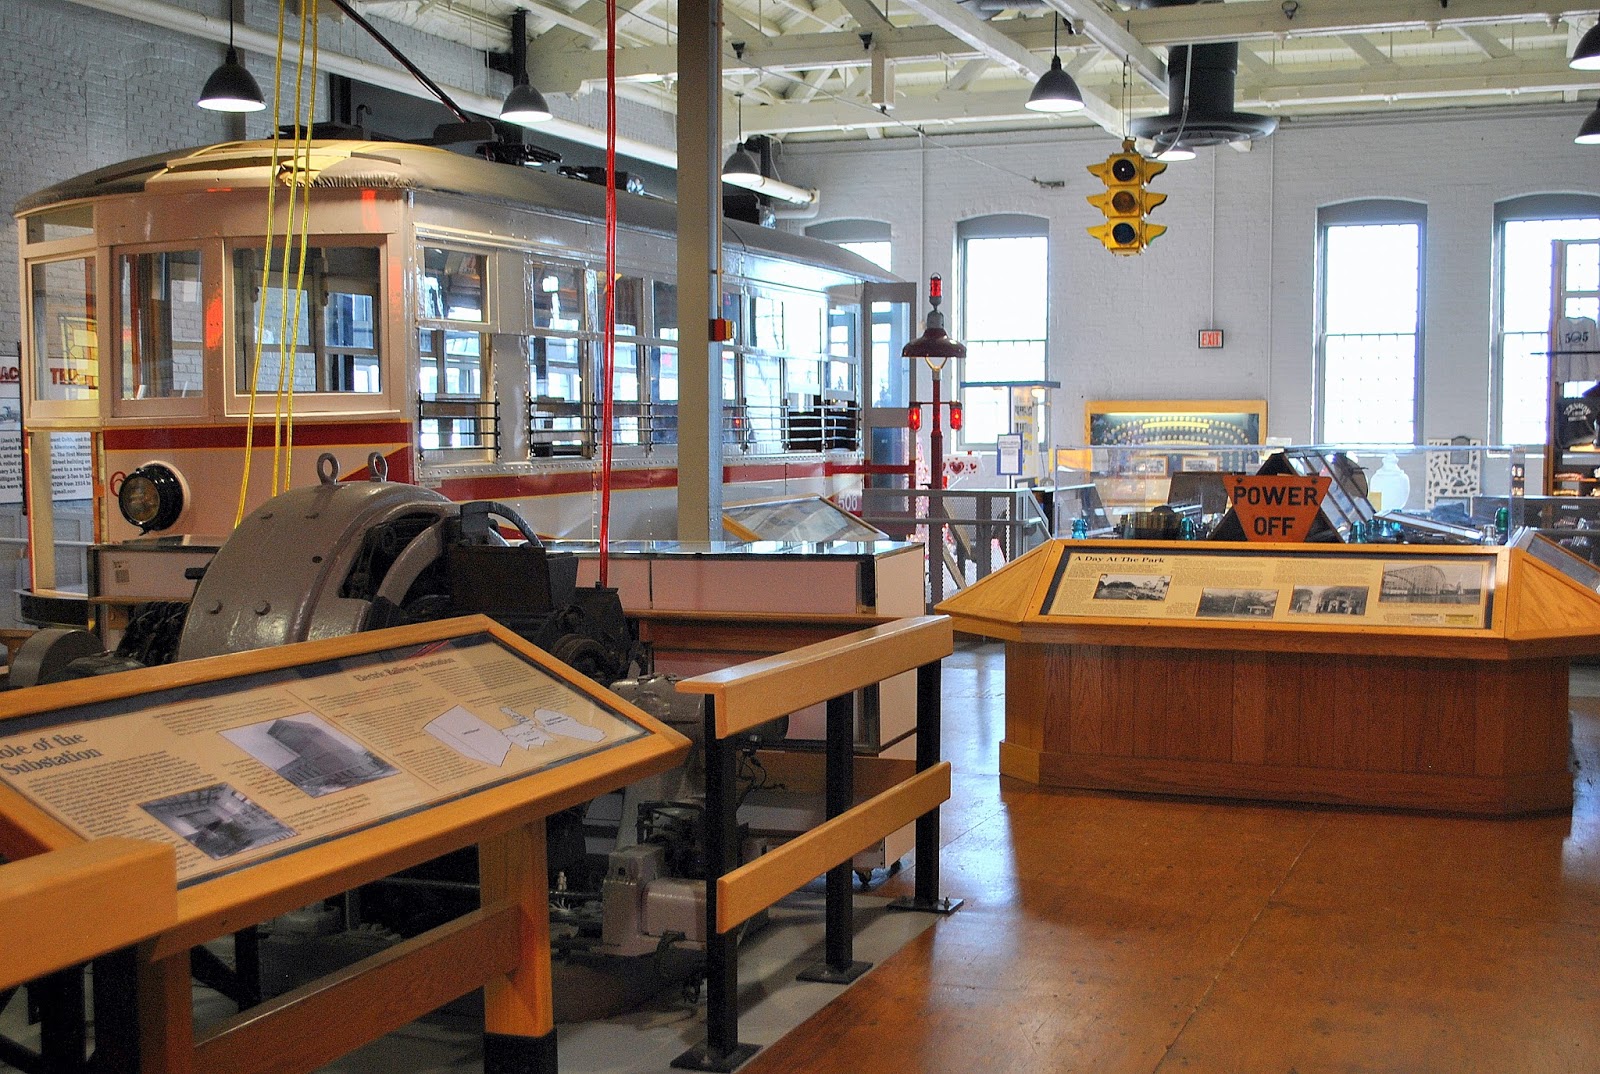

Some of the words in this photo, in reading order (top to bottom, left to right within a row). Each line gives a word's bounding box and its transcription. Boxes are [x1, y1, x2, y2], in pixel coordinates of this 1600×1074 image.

[1201, 332, 1220, 346] EXIT
[1233, 486, 1319, 507] POWER
[1254, 516, 1296, 536] OFF
[0, 744, 32, 760] ole
[32, 737, 55, 752] of
[52, 734, 88, 747] the
[0, 748, 104, 775] Substation
